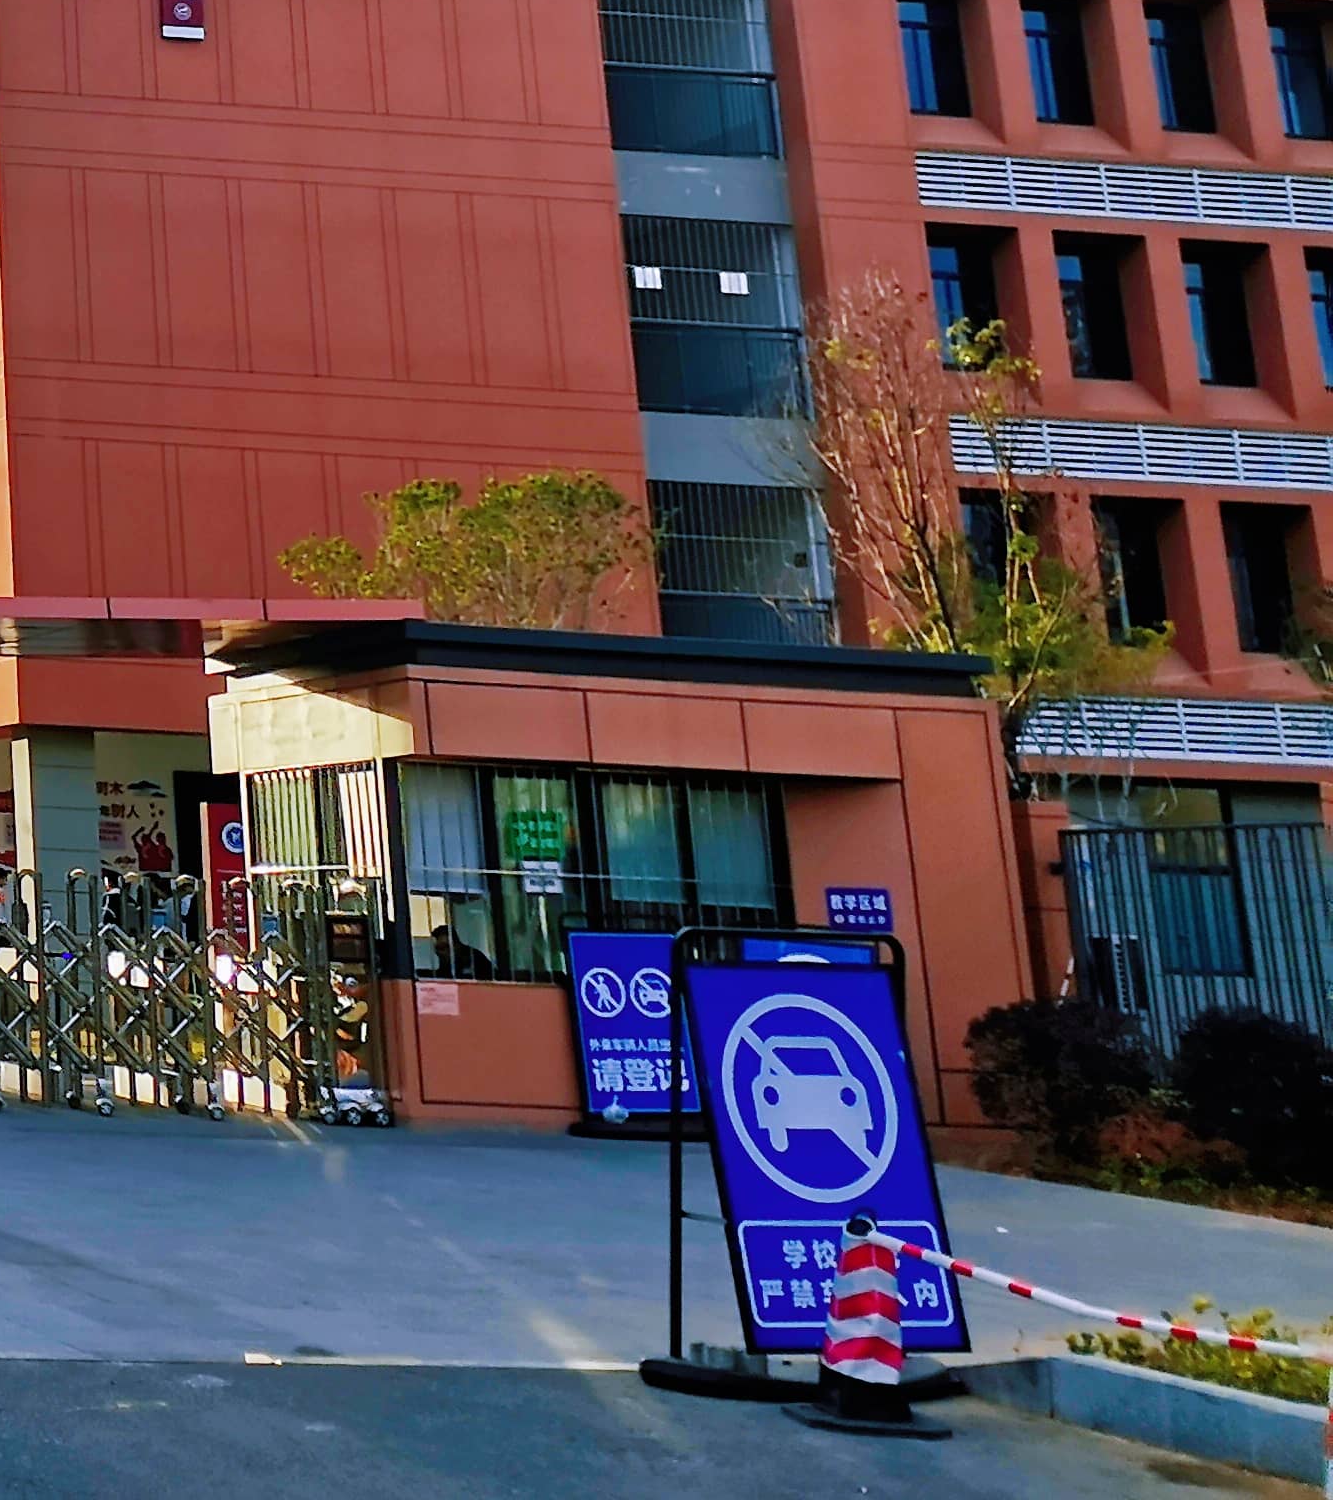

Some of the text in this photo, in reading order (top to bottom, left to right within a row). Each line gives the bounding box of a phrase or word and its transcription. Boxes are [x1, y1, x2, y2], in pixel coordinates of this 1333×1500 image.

[830, 894, 887, 911] 教学区域
[592, 1058, 690, 1092] 请登记
[759, 1278, 939, 1308] 严禁内
